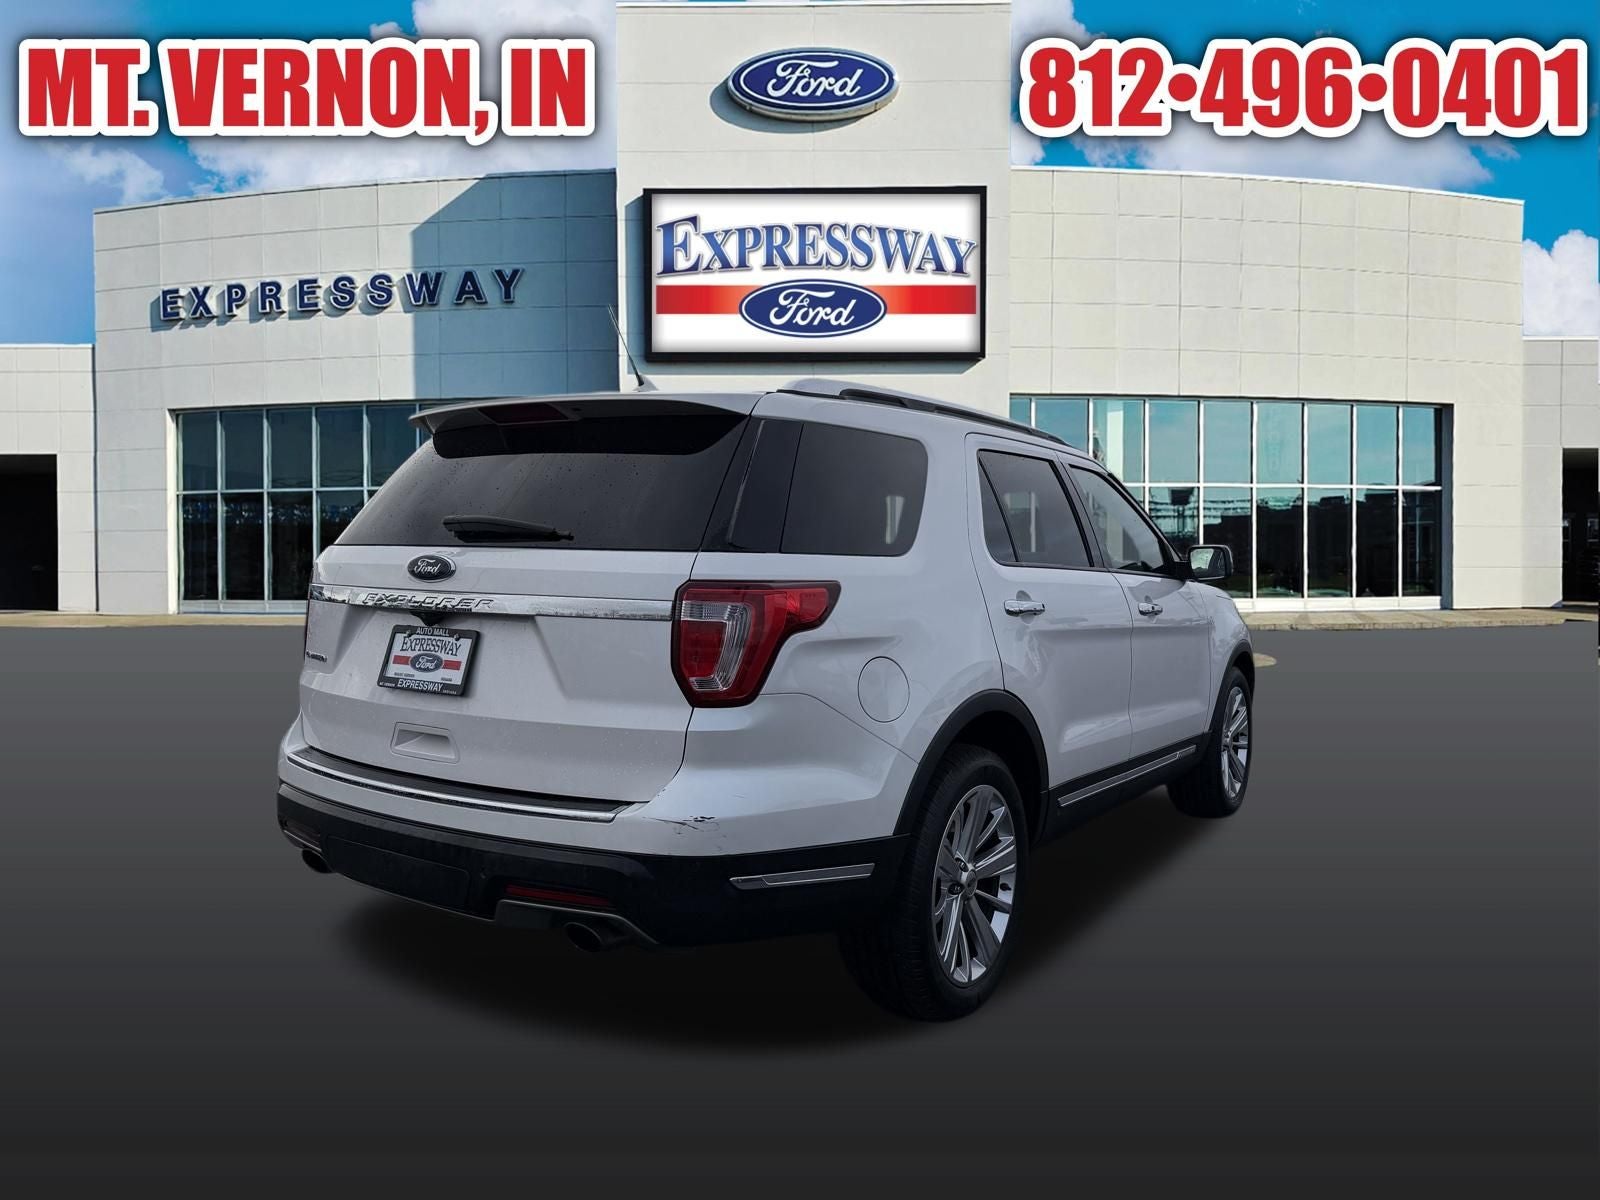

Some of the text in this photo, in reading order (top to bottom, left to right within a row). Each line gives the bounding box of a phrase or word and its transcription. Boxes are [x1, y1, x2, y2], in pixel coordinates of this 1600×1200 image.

[767, 59, 863, 97] Ford
[656, 214, 977, 276] EXPRESSWAY
[160, 268, 526, 322] EXPRESSWAY
[769, 289, 857, 325] Ford
[413, 559, 441, 574] Ford
[362, 592, 494, 608] EXPLORER
[416, 627, 449, 637] AUTO MALL
[400, 636, 461, 656] EXPRESSWAY
[415, 656, 437, 669] Ford
[397, 679, 443, 692] EXPRESSWAY
